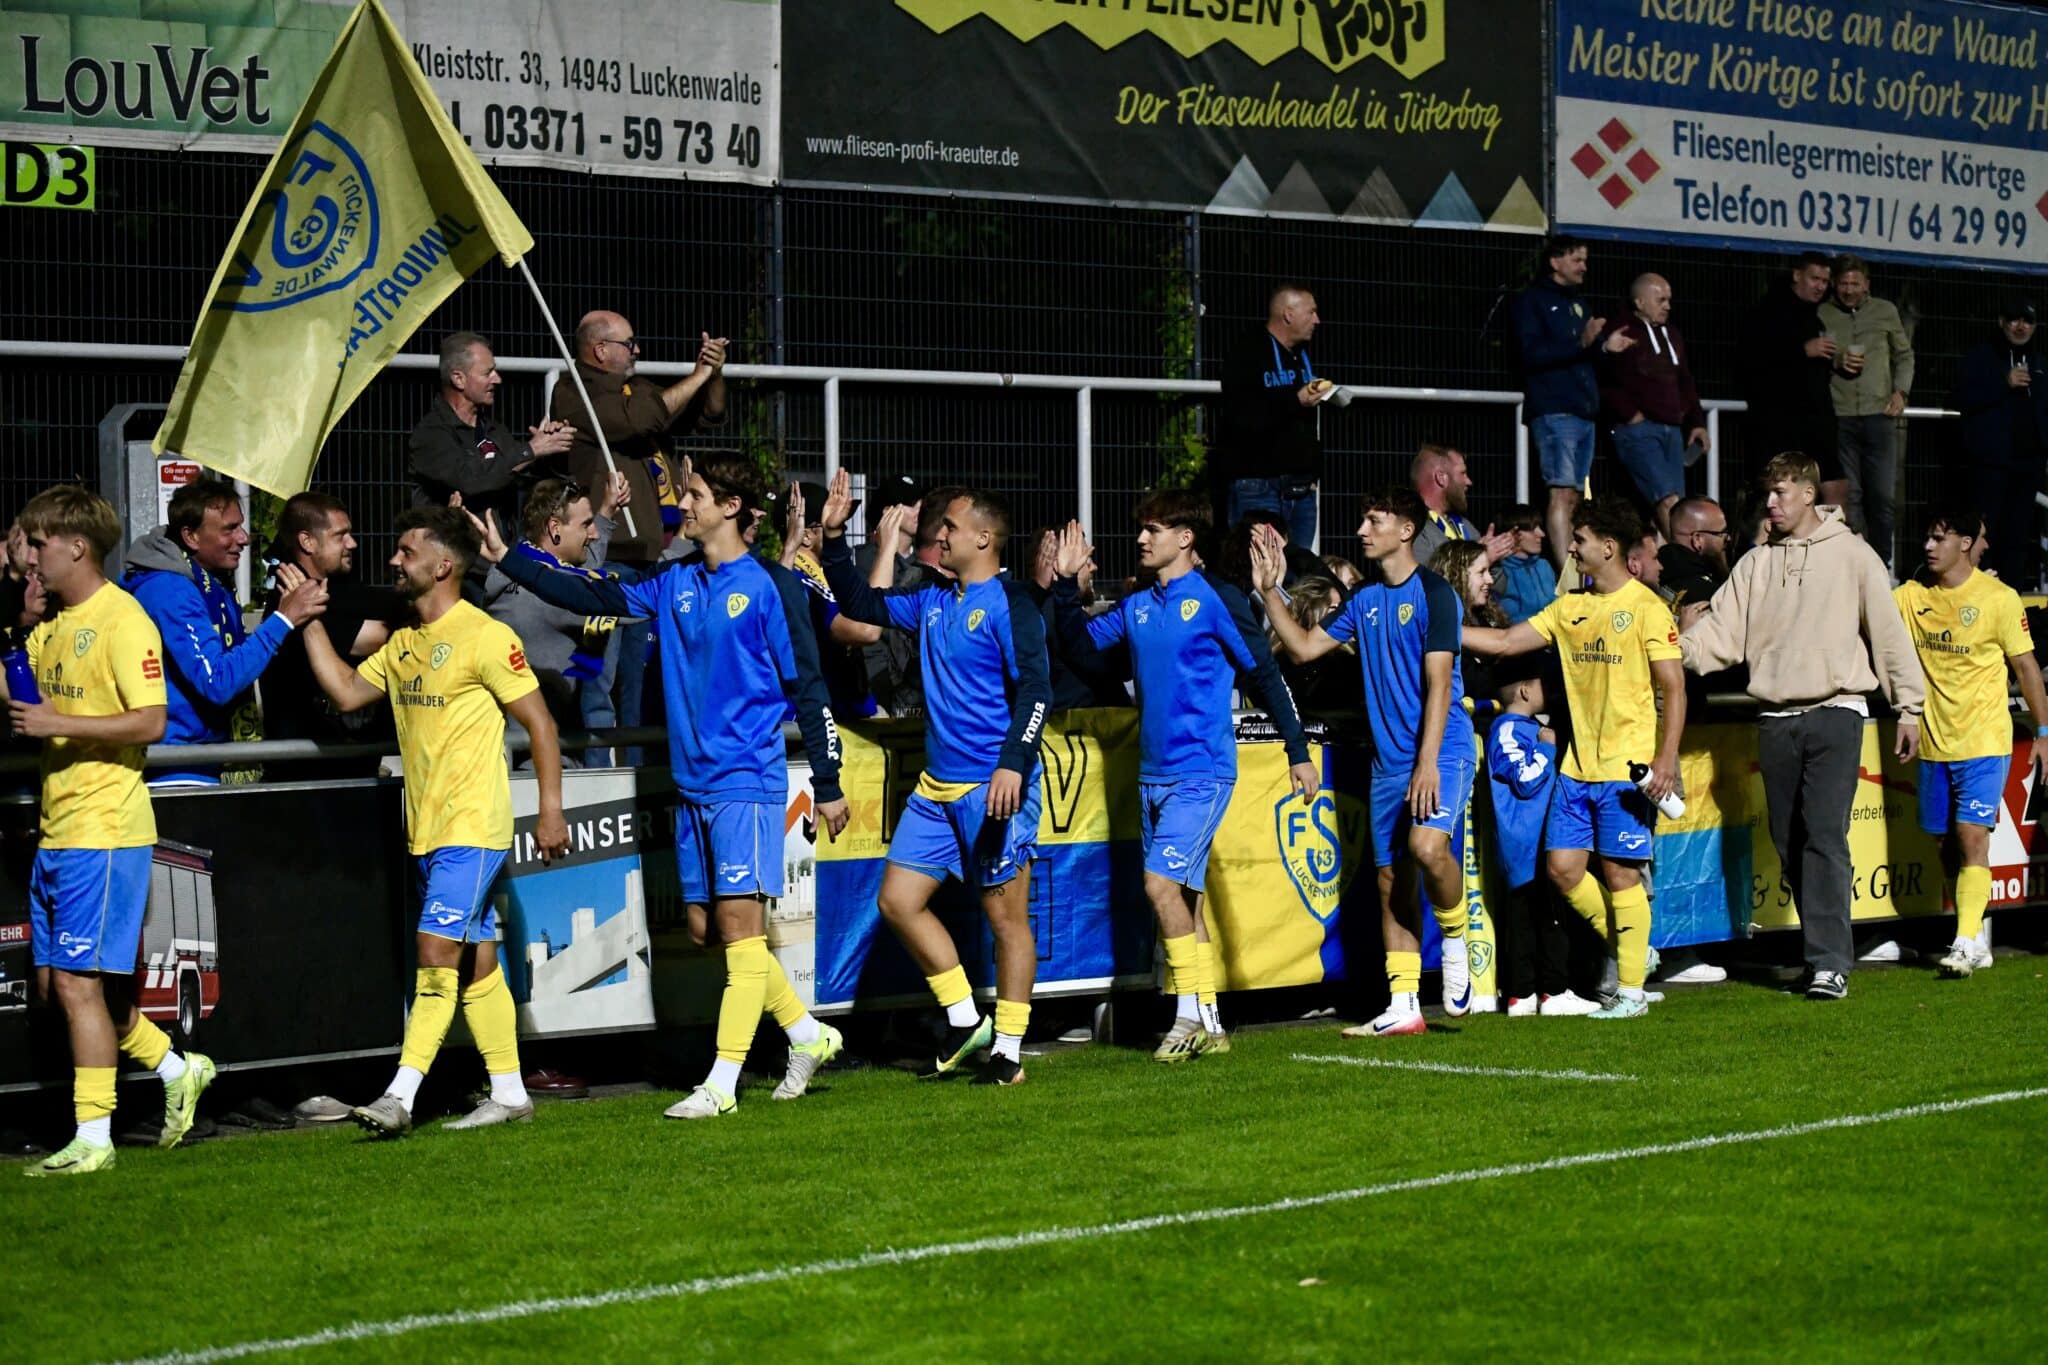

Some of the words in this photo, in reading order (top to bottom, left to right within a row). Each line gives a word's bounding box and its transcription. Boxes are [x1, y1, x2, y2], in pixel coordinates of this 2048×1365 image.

[413, 42, 511, 83] Kleiststr.
[519, 51, 550, 90] 33,
[560, 56, 621, 94] 14943
[630, 62, 762, 106] Luckenwalde
[1842, 12, 1884, 49] an
[1891, 10, 1944, 57] der
[1953, 15, 2038, 70] Wand
[19, 34, 271, 125] LouVet
[1568, 25, 1700, 86] Meister
[1708, 42, 1819, 109] Körtge
[1828, 58, 1867, 106] ist
[1873, 70, 1964, 121] sofort
[1971, 90, 2022, 131] zur
[484, 103, 586, 156] 03371
[623, 116, 663, 161] 59
[673, 119, 714, 165] 73
[727, 123, 761, 169] 40
[1115, 86, 1170, 126] Der
[1177, 81, 1360, 131] Fliesenhandel
[1365, 89, 1388, 130] in
[1394, 87, 1502, 151] Jüterbog
[4, 142, 90, 206] D3
[806, 134, 1019, 168] www.fliesen-profi-kraeuter.de
[1672, 119, 1933, 183] Fliesenlegermeister
[1941, 149, 2026, 199] Körtge
[1673, 178, 1788, 229] Telefon
[1908, 201, 1942, 244] 64
[1951, 204, 1985, 246] 29
[1994, 207, 2027, 249] 99
